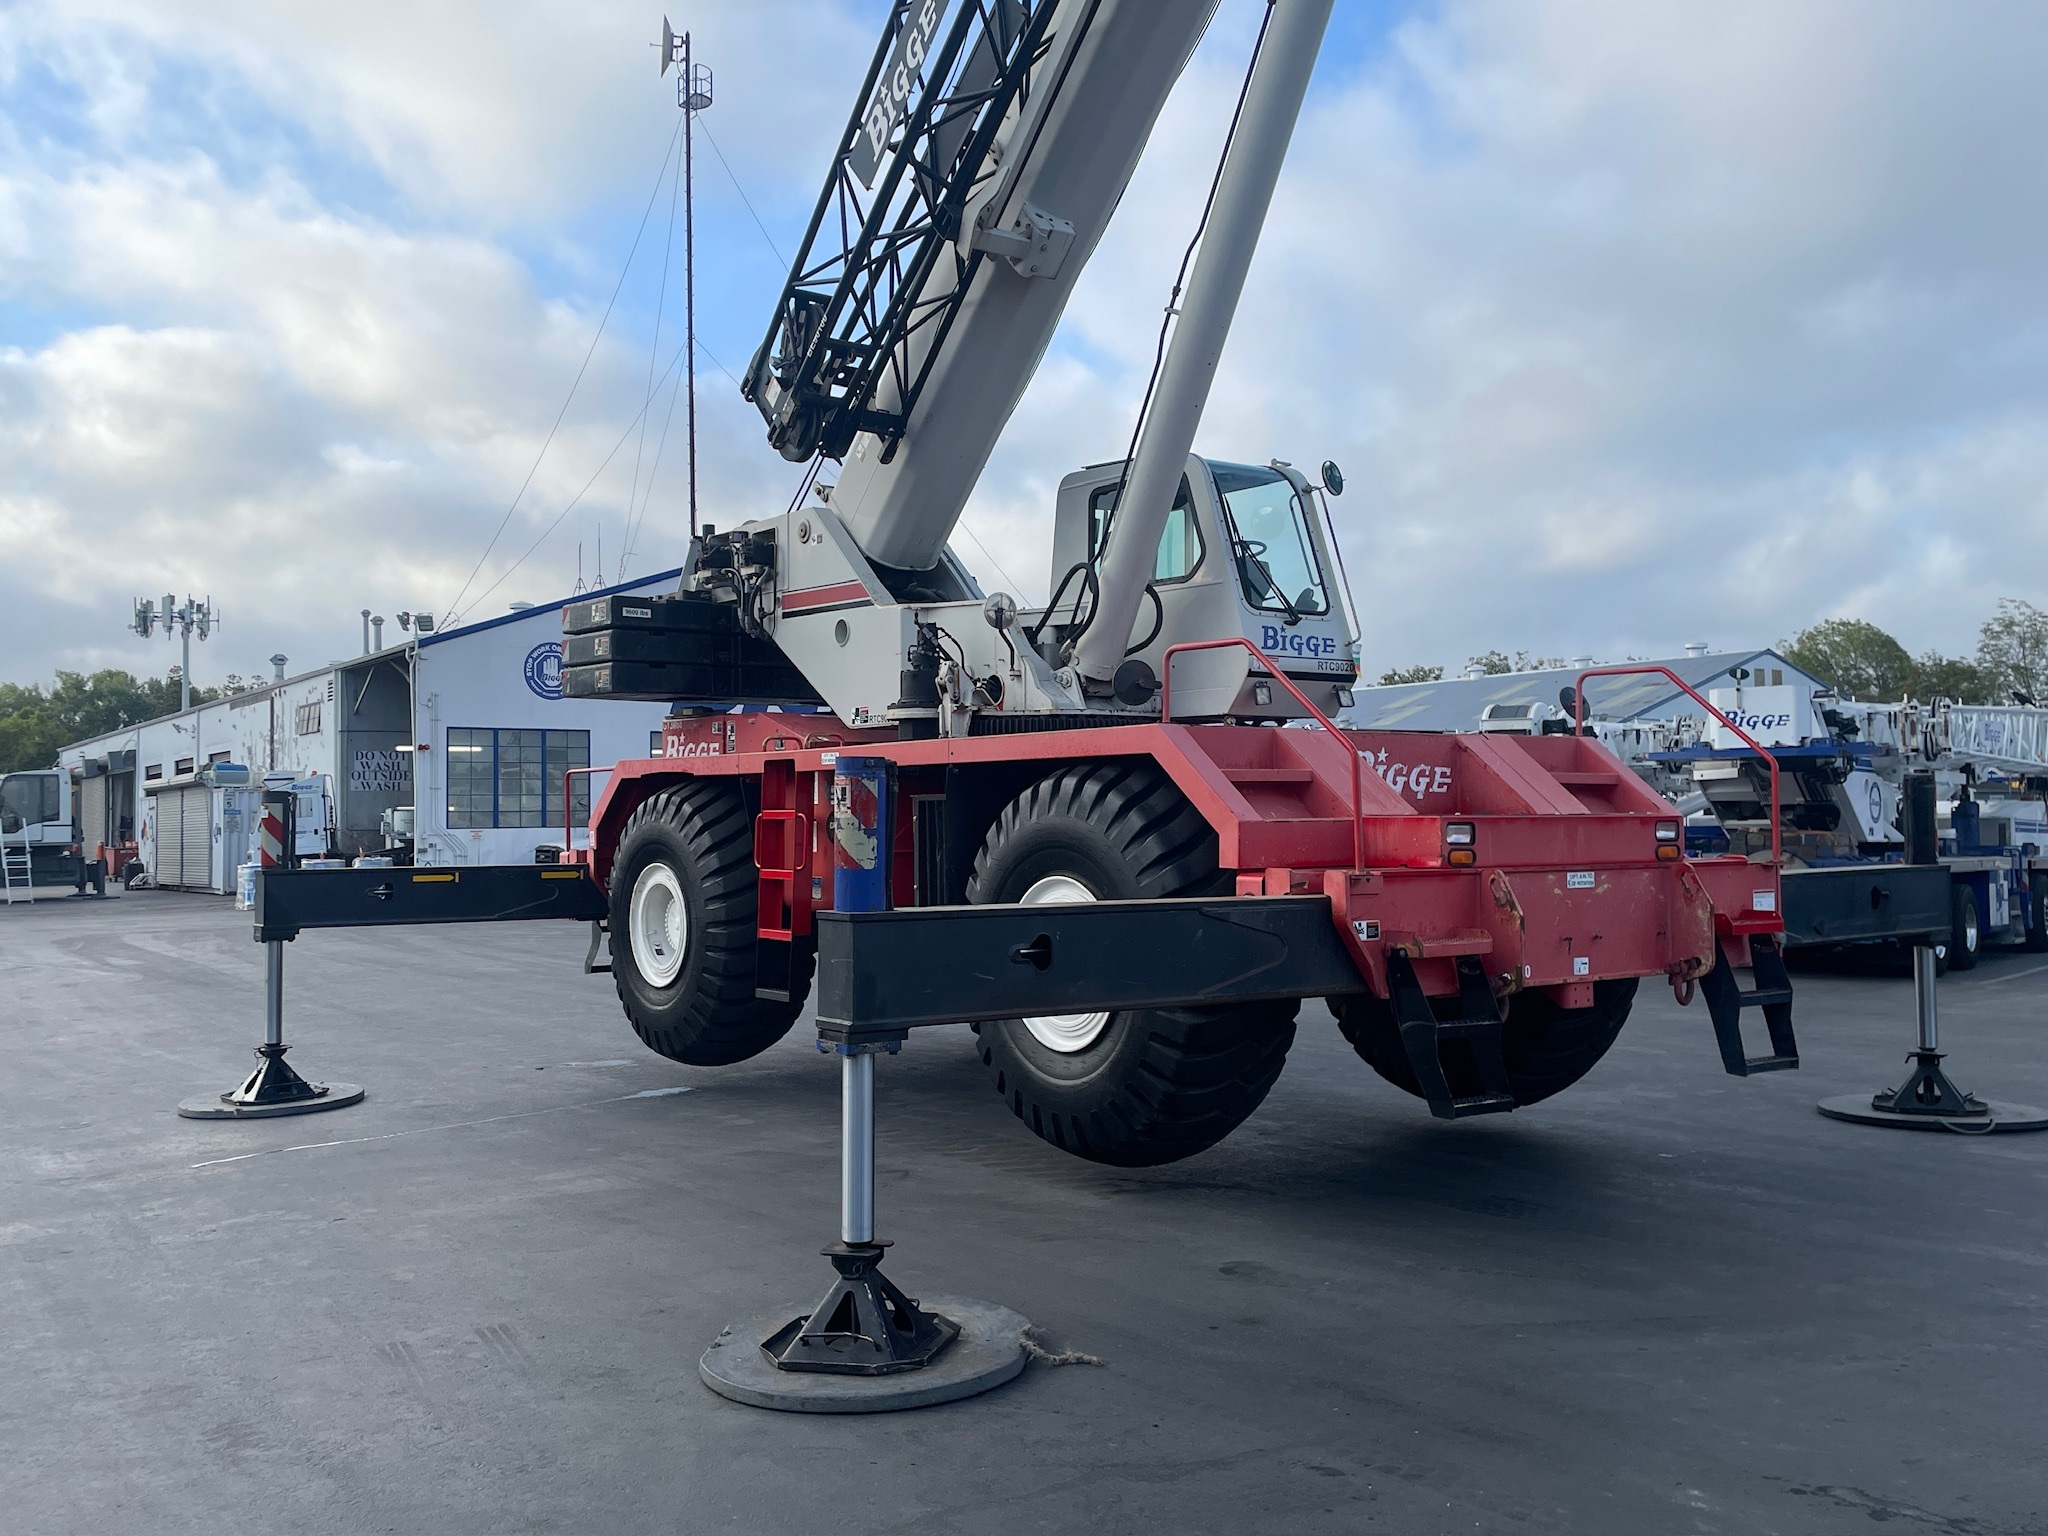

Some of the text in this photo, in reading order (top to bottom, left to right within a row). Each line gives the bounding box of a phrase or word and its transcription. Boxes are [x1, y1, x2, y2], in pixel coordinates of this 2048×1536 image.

[531, 645, 551, 658] WORK
[1317, 661, 1355, 672] RTC9020
[355, 751, 407, 761] DO NOT
[359, 761, 401, 771] WASH
[351, 771, 412, 781] OUTSIDE
[360, 781, 402, 791] WASH
